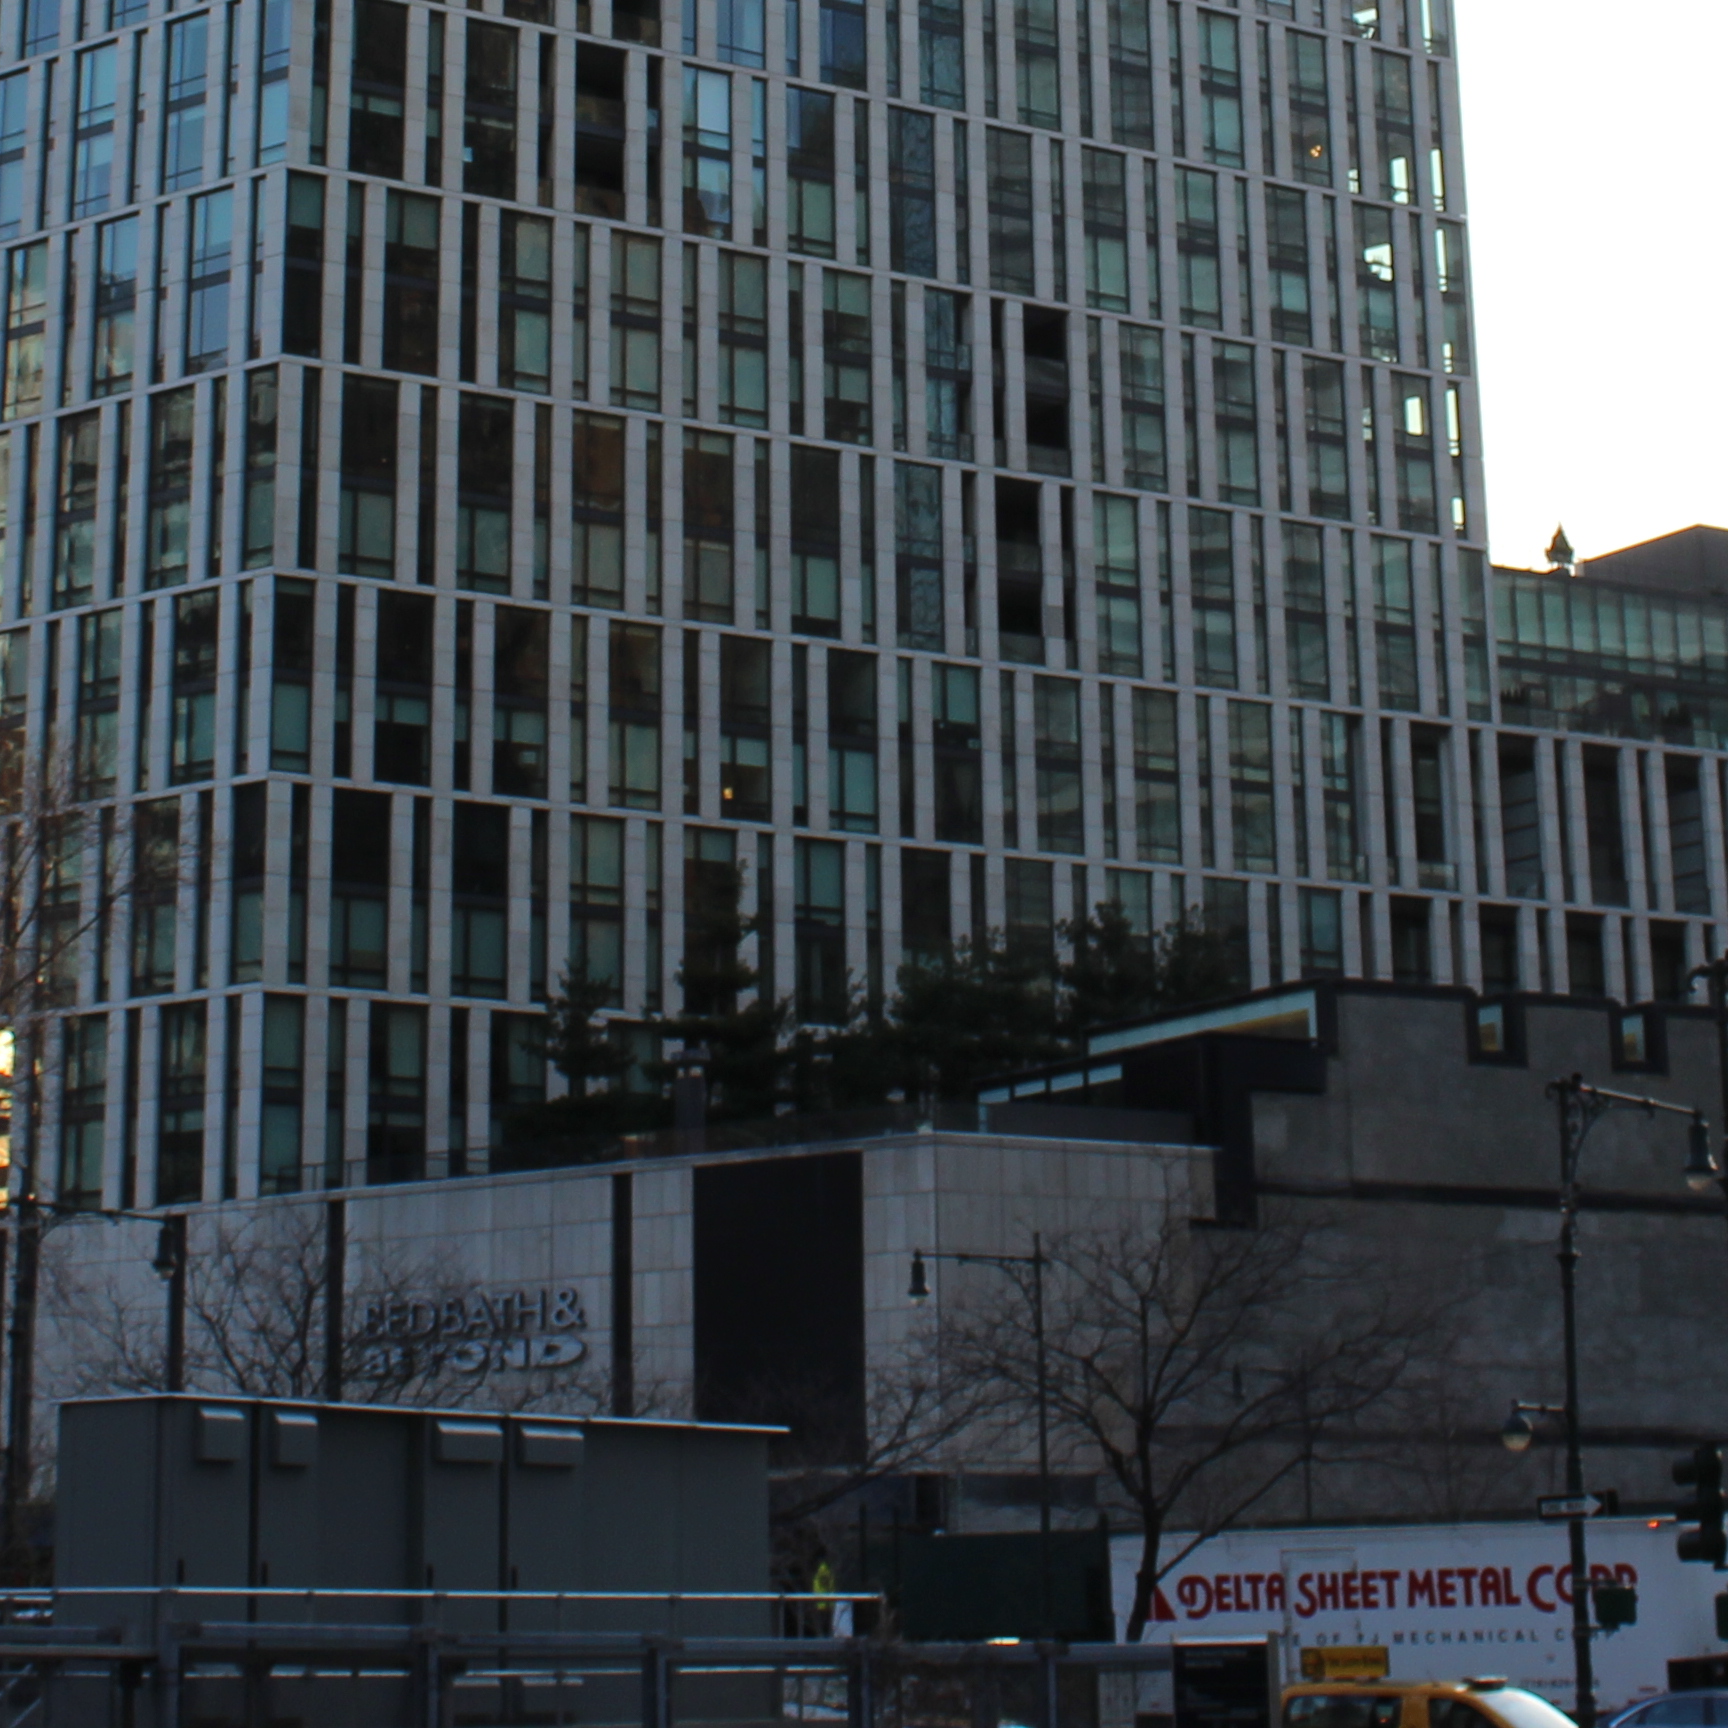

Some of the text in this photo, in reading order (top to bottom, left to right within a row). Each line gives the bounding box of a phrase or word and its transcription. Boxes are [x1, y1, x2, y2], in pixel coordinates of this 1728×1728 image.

[365, 1287, 587, 1339] BED BATH &
[1177, 1573, 1285, 1619] DELTA
[1295, 1570, 1400, 1618] SHEET
[1408, 1566, 1521, 1608] METAL
[1393, 1629, 1539, 1645] MECHANICAL
